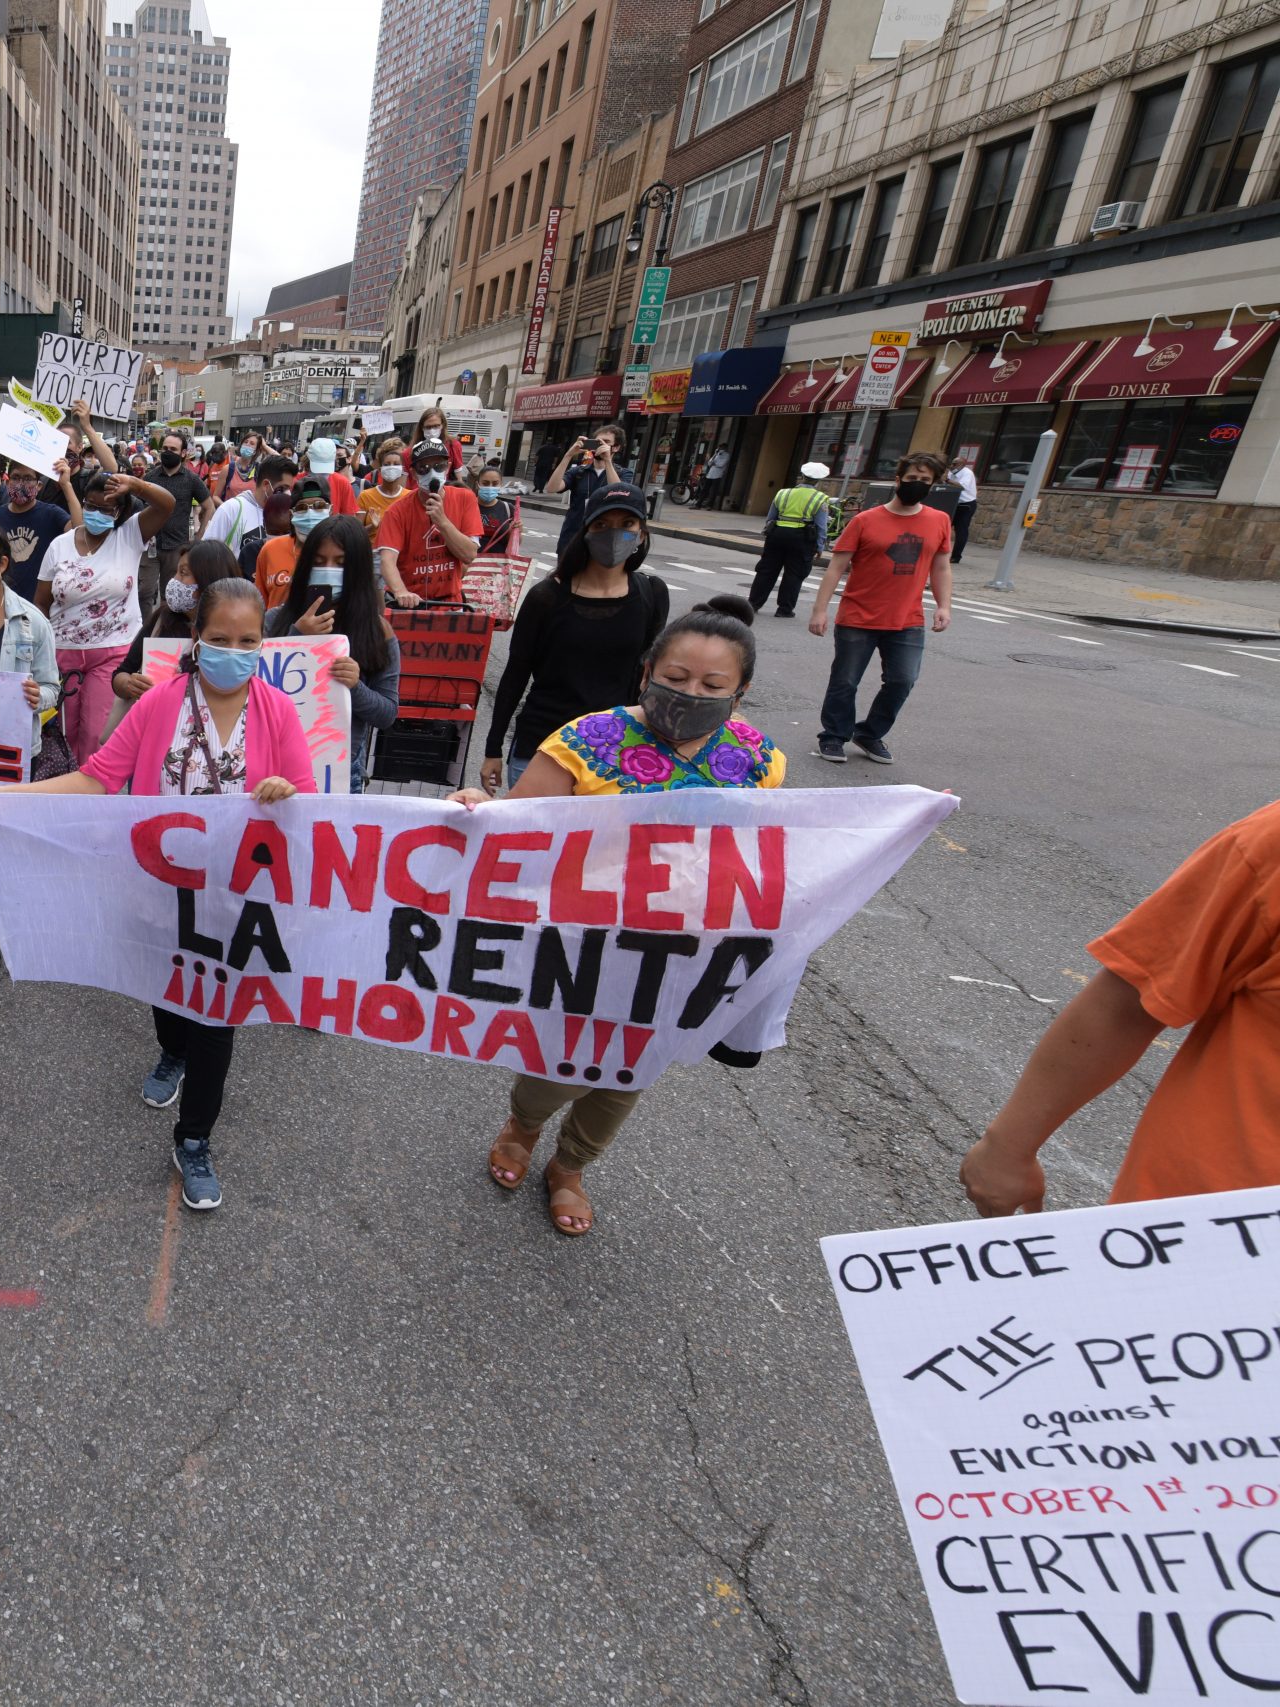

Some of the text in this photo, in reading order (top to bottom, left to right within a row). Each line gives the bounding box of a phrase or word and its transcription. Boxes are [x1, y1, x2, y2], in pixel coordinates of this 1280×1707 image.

[524, 209, 560, 372] DELI SALAD BAR PIZZERIA
[945, 294, 999, 313] THE NEW
[73, 299, 83, 334] PARK
[917, 305, 1022, 339] APOLLO DINER
[40, 333, 140, 377] POVERTY
[879, 334, 902, 343] NEW
[77, 366, 88, 377] IS
[281, 367, 301, 380] DENTAL
[307, 367, 356, 377] DENTAL
[36, 369, 134, 419] VIOLENCE
[520, 390, 583, 410] SMITH FOOD EXPRESS
[966, 391, 1009, 404] LUNCH
[1108, 382, 1171, 397] DINNER
[767, 404, 800, 413] CATERING
[414, 442, 444, 457] BROOKLYN
[1209, 427, 1241, 439] OPEN
[6, 526, 35, 541] ALOHA
[412, 561, 455, 575] JUSTICE
[400, 641, 485, 662] KLYN,NY
[130, 811, 786, 932] CANCELEN
[176, 887, 292, 973] LA
[385, 907, 774, 1030] RENTA
[162, 954, 656, 1085] ¡¡¡AHORA!!!
[838, 1235, 1069, 1293] OFFICE
[1099, 1221, 1186, 1269] OF
[903, 1315, 1280, 1394] THE PEOP
[1022, 1394, 1176, 1439] against
[949, 1440, 1156, 1476] EVICTION
[914, 1484, 1131, 1520] OCTOBER
[1206, 1484, 1280, 1510] 20
[936, 1530, 1280, 1598] CERTIFIC
[997, 1609, 1280, 1698] EVIC
